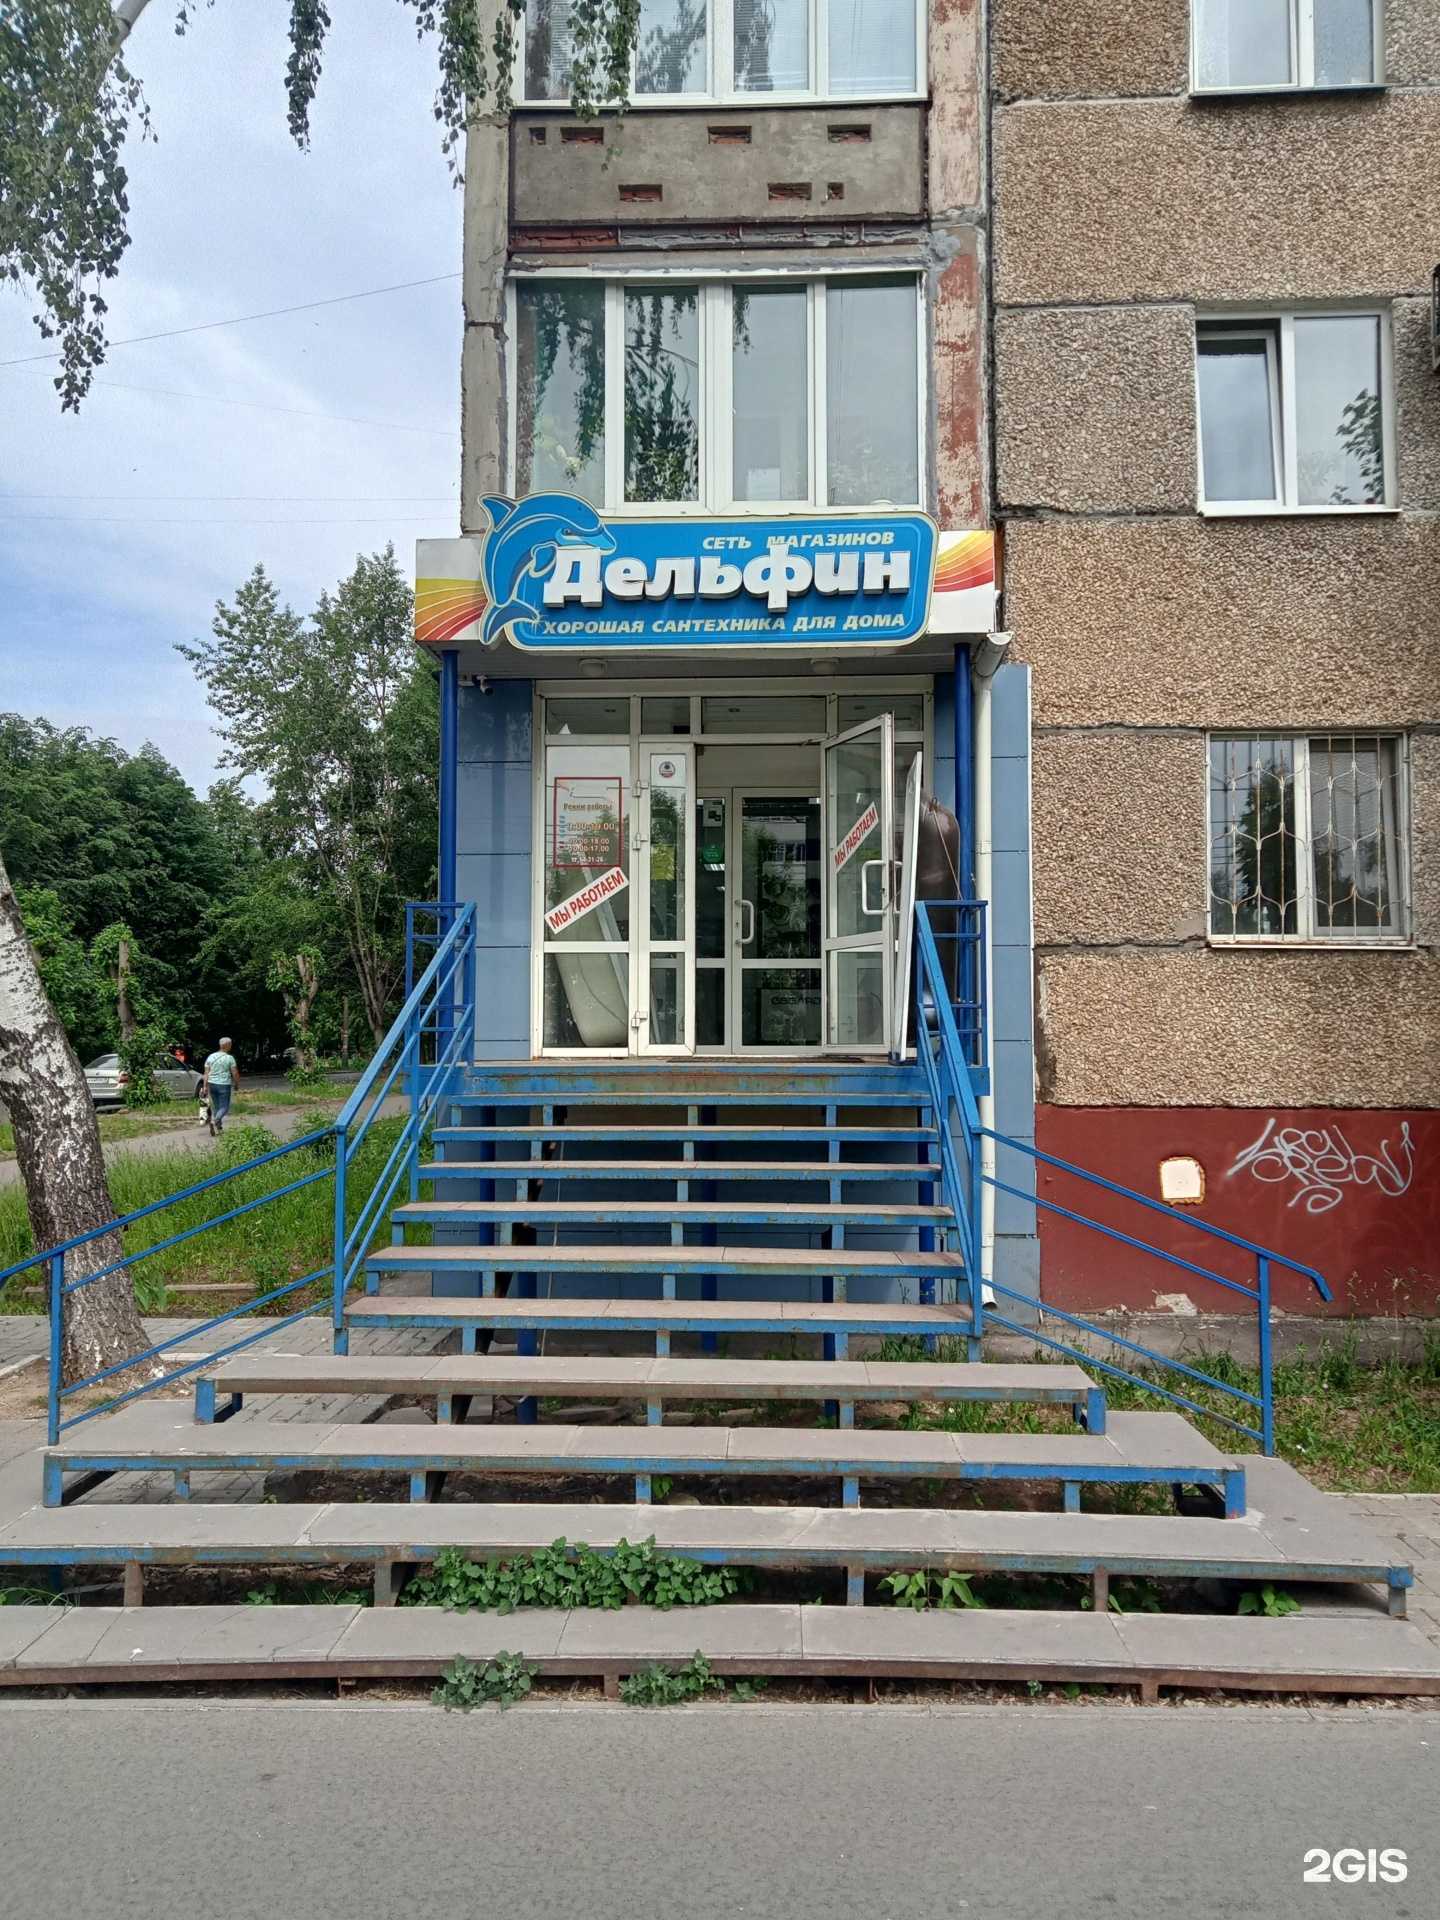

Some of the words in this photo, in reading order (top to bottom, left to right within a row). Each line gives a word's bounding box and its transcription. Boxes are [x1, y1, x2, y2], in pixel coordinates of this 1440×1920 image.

[703, 536, 752, 549] СЕТЬ
[766, 532, 895, 548] МАГАЗИНОВ
[543, 544, 911, 612] Дельфин
[543, 620, 645, 634] ХОРОШАЯ
[651, 617, 786, 633] САНТЕХНИКА
[793, 616, 836, 632] ДЛЯ
[843, 614, 905, 631] ДОМА
[835, 843, 847, 865] МЫ
[845, 807, 876, 855] РАБОТАЕМ
[549, 906, 571, 929] МЫ
[570, 870, 625, 915] РАБОТАЕМ
